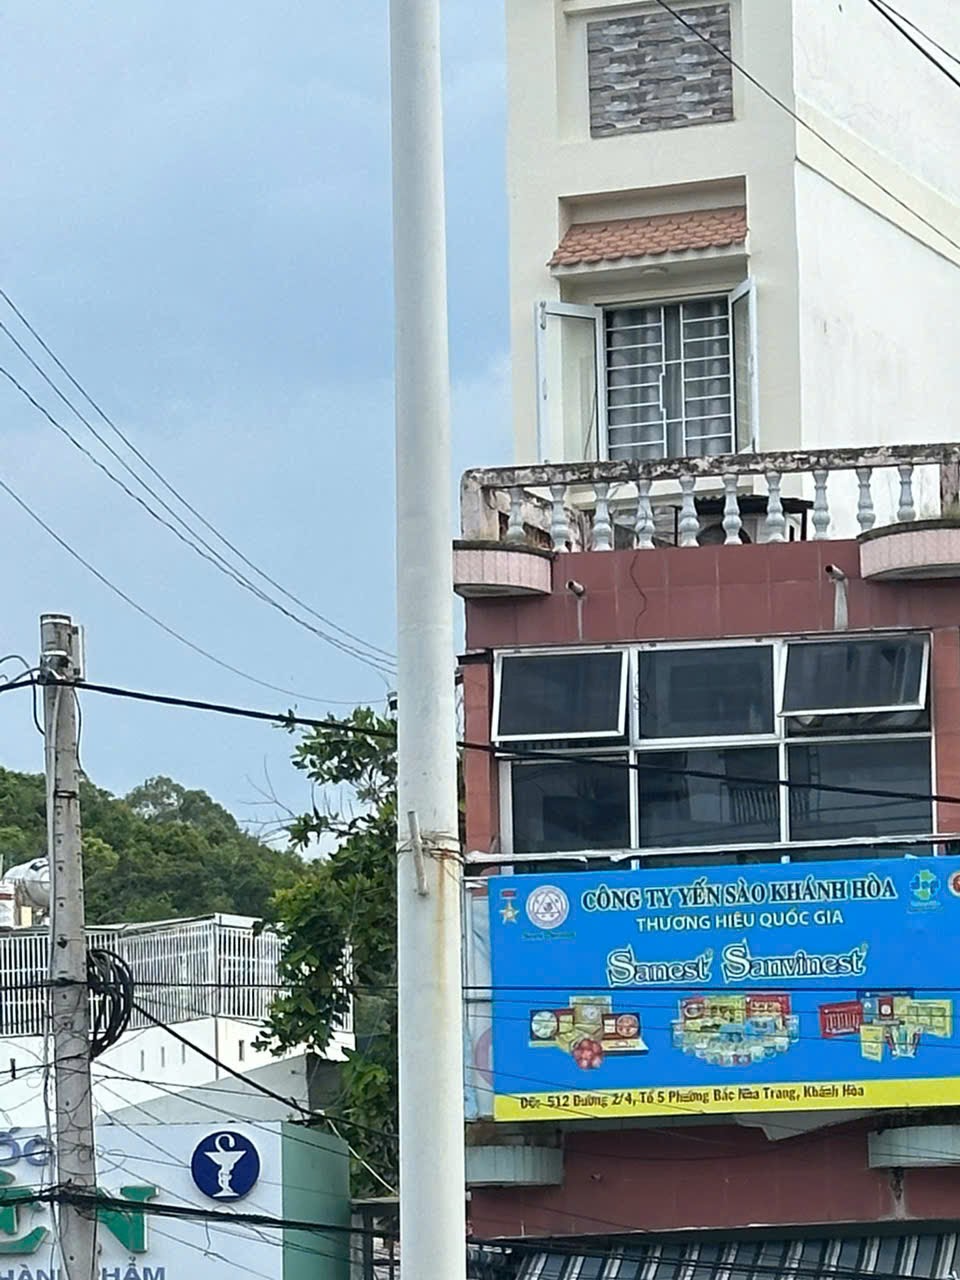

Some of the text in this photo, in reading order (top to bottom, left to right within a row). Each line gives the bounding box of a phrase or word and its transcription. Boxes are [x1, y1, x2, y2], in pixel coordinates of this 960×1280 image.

[581, 871, 898, 912] CÔNG TY YẾN SÀO KHÁNH HÒA
[636, 915, 711, 932] THƯƠNG
[814, 909, 843, 925] GIA
[606, 937, 867, 988] Sanest Sanvinest
[547, 1095, 569, 1108] 512
[657, 1091, 665, 1103] 5
